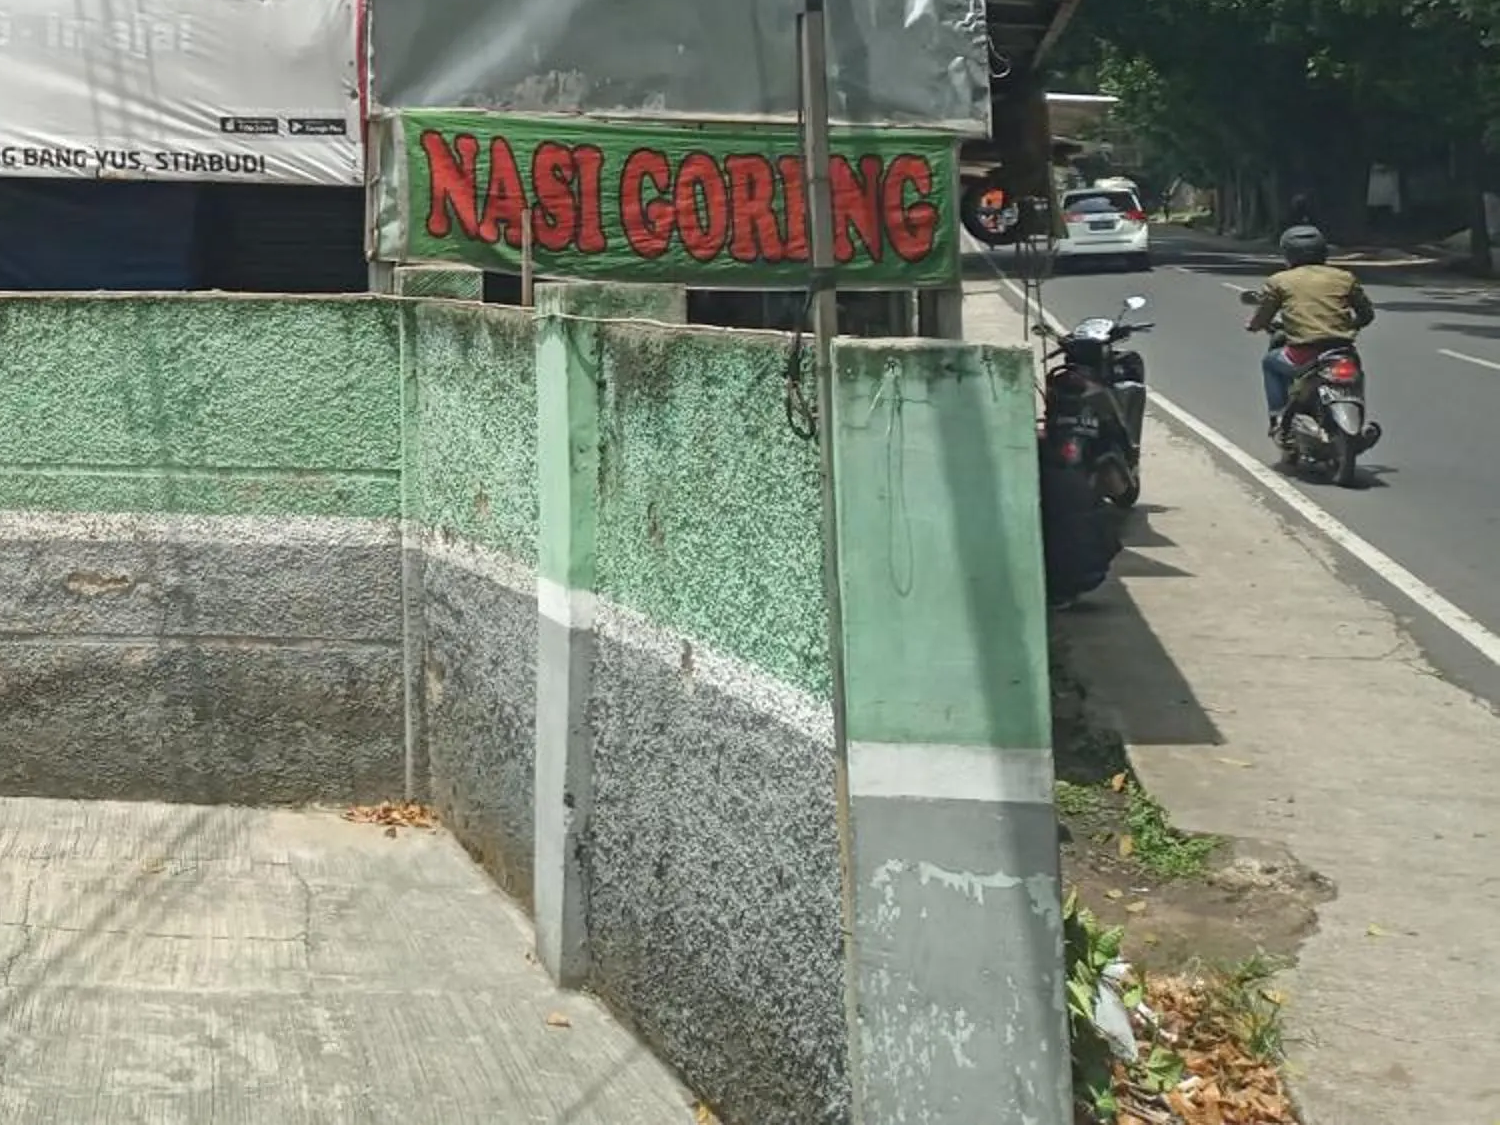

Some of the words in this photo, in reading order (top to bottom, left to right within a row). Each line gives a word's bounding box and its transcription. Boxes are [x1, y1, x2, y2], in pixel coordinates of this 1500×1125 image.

[23, 146, 88, 168] BANG
[95, 150, 147, 173] YUS,
[420, 130, 607, 254] NASI
[619, 147, 940, 264] GORING
